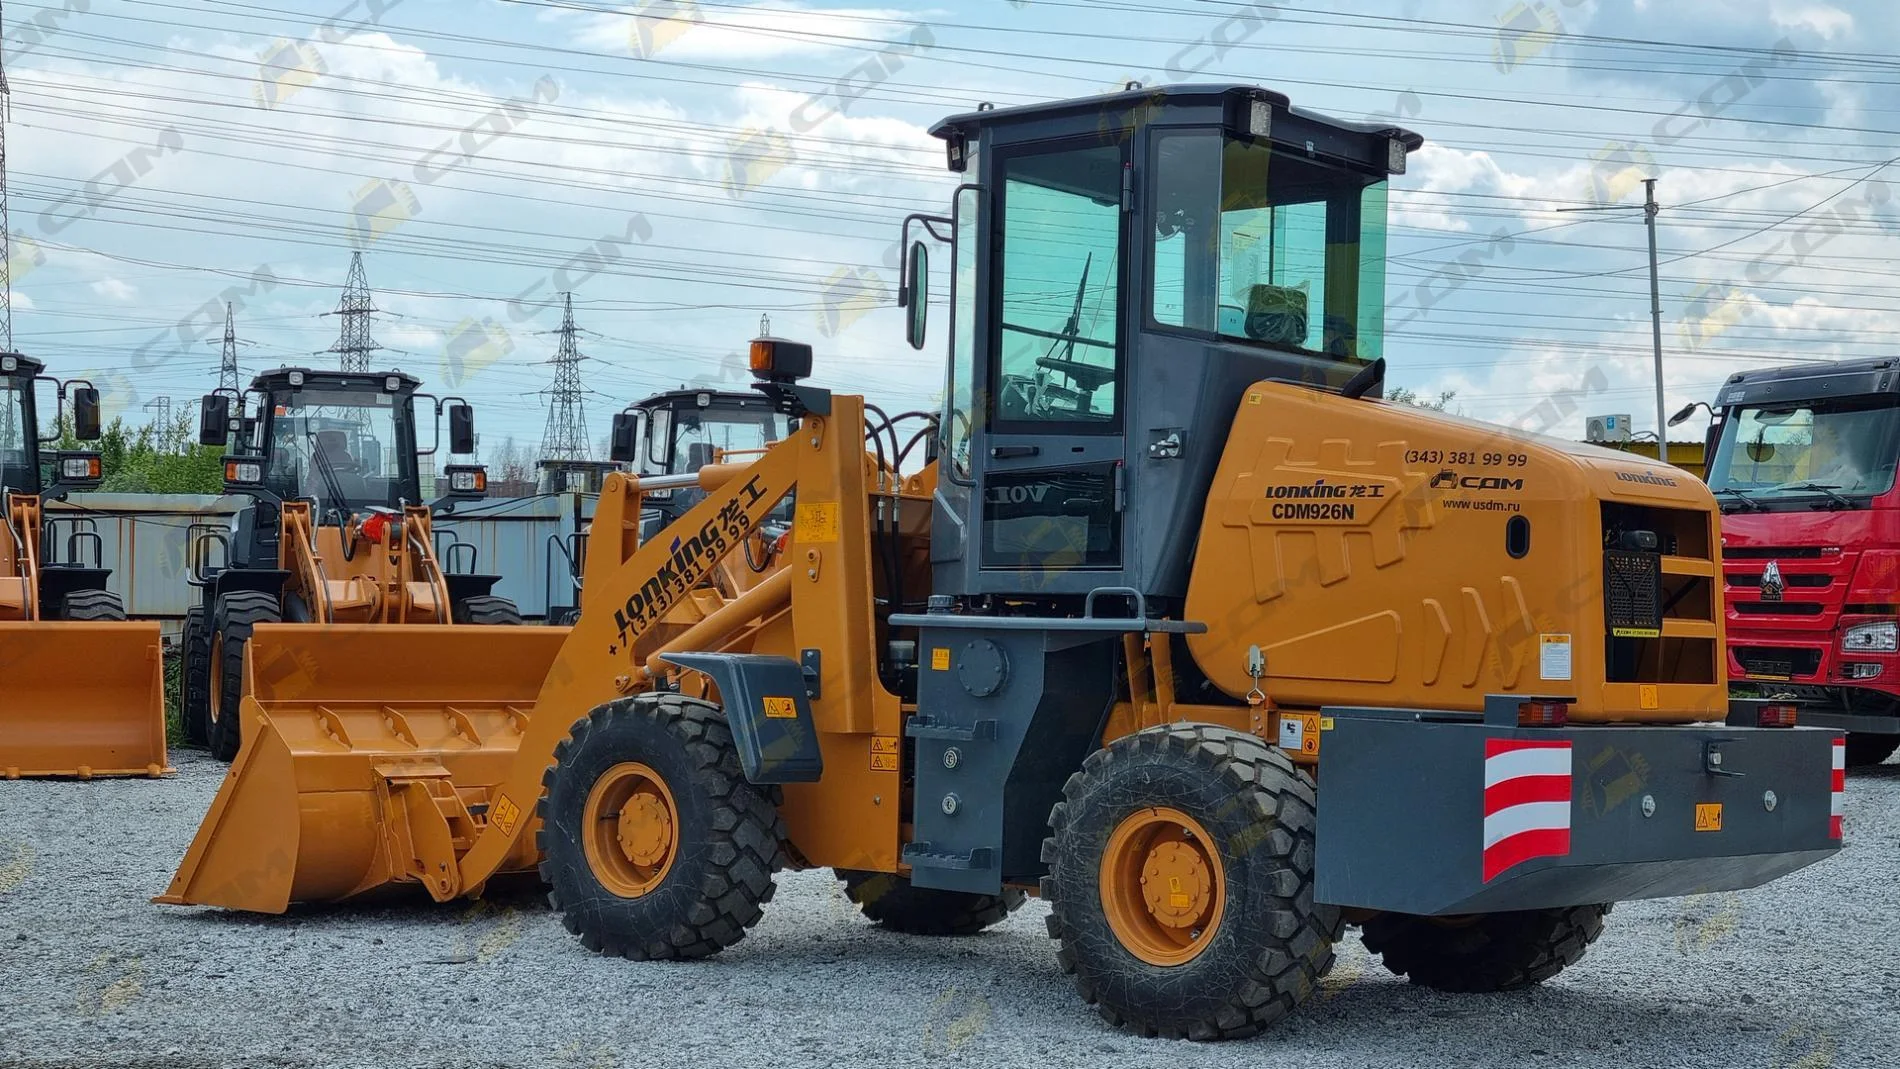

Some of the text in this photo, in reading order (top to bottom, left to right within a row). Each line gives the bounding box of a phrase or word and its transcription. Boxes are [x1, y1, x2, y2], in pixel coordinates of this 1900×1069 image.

[1404, 449, 1528, 467] (343) 381 99 99
[1349, 484, 1385, 498] 龙工
[716, 473, 768, 531] 龙工
[1272, 503, 1355, 520] CDM926N
[705, 538, 727, 563] 99
[728, 516, 750, 540] 99
